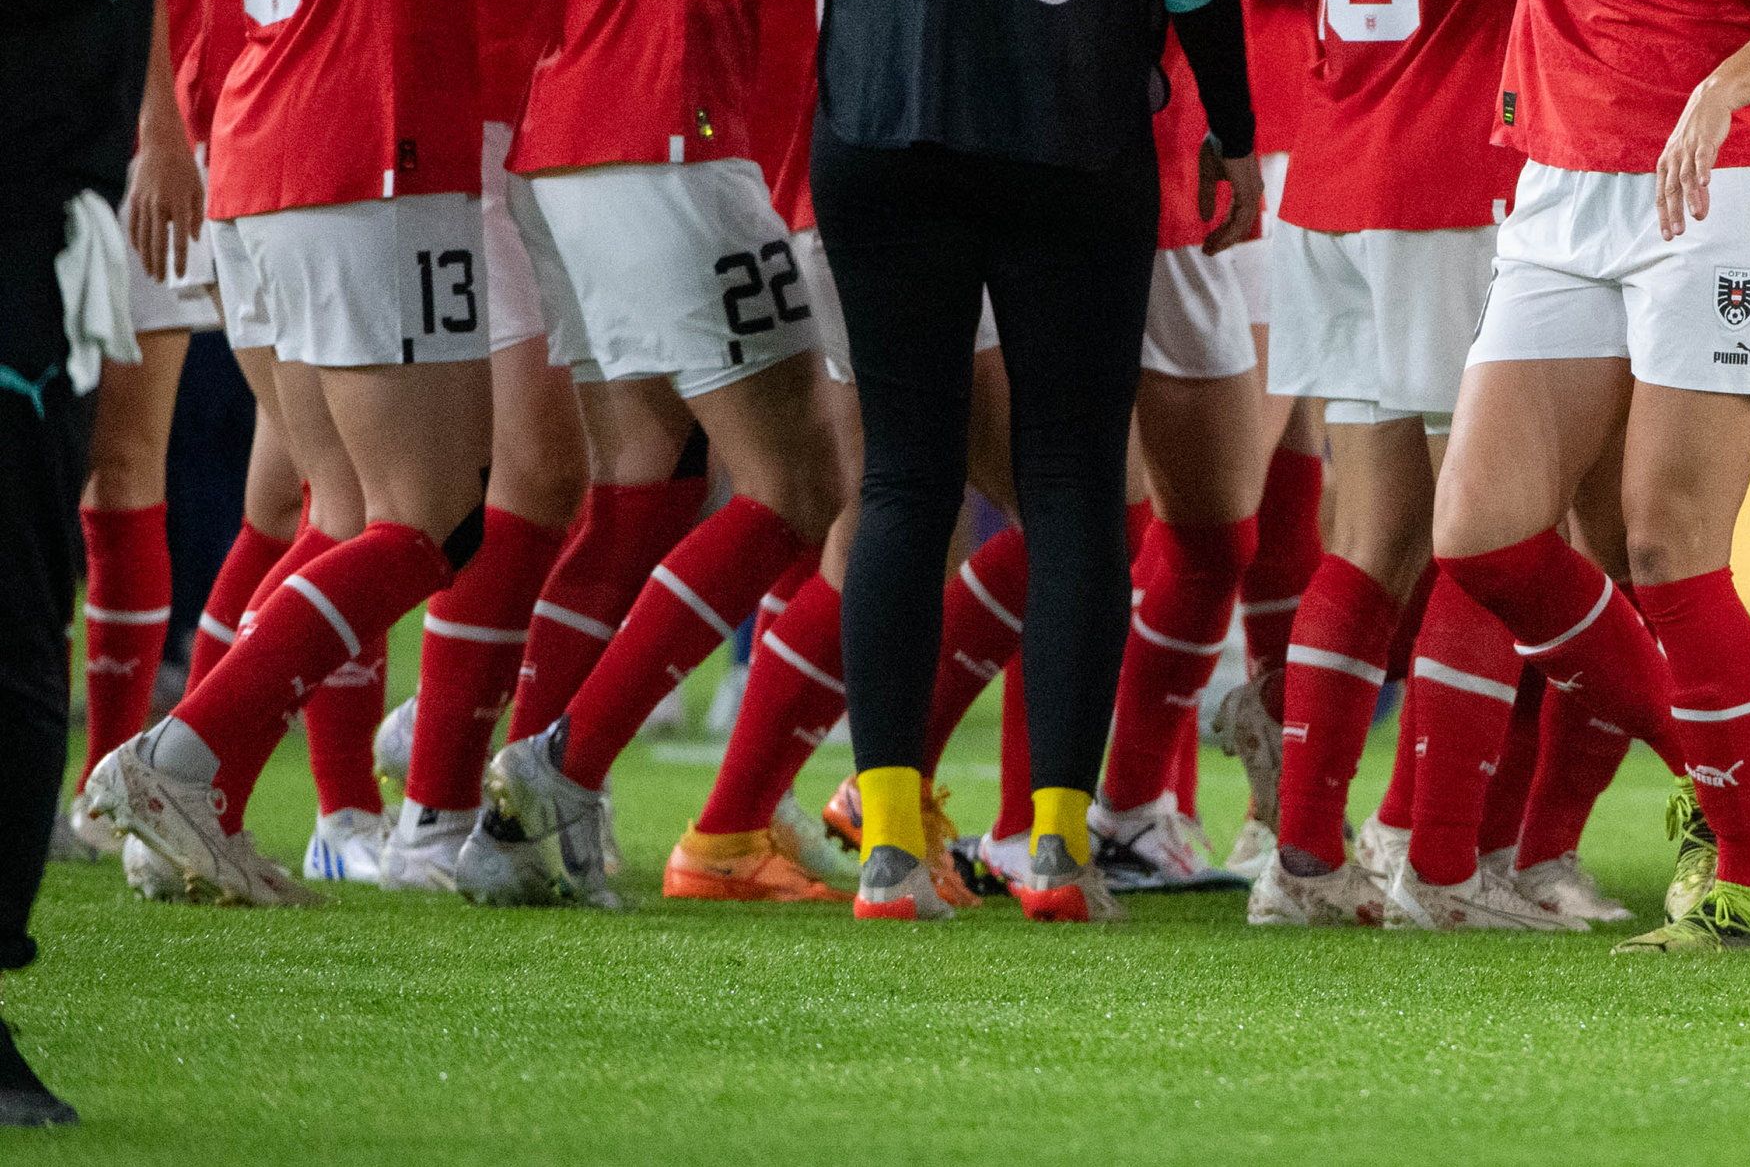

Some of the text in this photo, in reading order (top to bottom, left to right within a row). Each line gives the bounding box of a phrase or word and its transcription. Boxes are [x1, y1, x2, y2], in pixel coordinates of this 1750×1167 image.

[417, 248, 477, 334] 13
[714, 239, 811, 335] 22
[1713, 351, 1749, 365] PUMA
